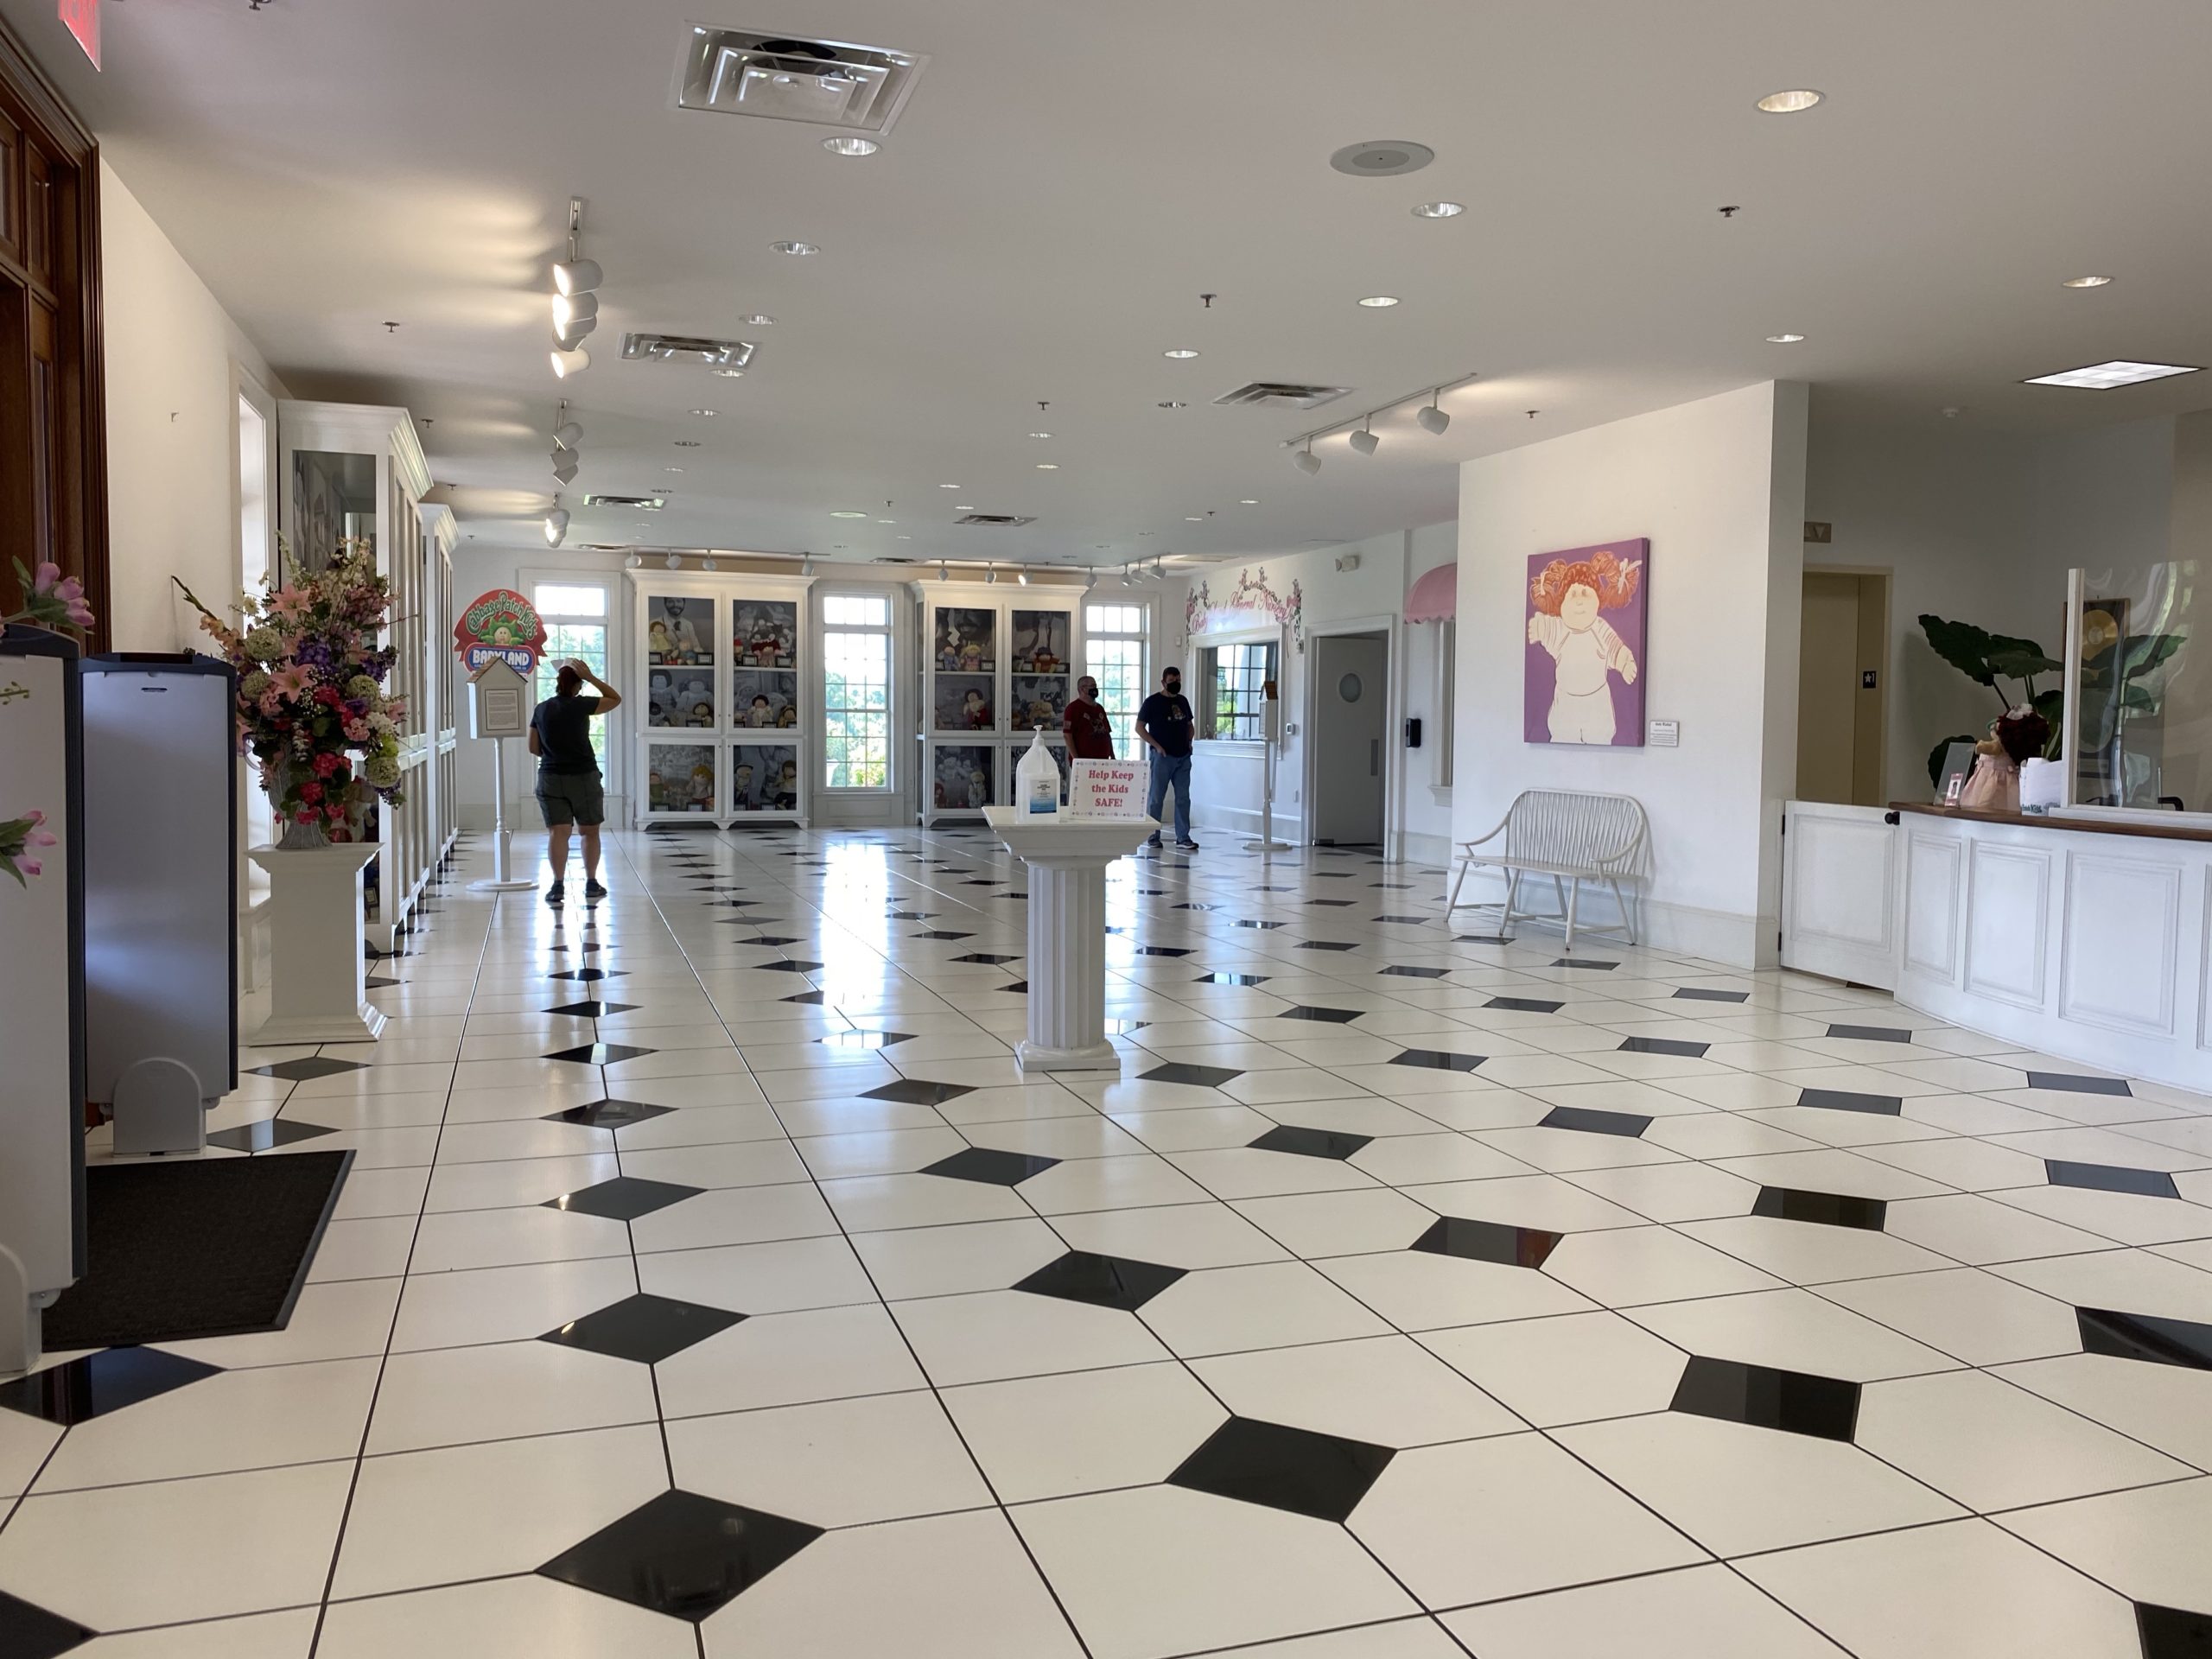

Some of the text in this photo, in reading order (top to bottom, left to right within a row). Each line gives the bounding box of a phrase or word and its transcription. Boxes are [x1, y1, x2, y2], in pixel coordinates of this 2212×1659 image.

[1230, 591, 1257, 610] General
[466, 591, 537, 640] Cabbage Patch Kids
[1089, 770, 1134, 781] Help Keep
[1091, 785, 1128, 793] the Kids
[1095, 798, 1122, 807] SAFE!
